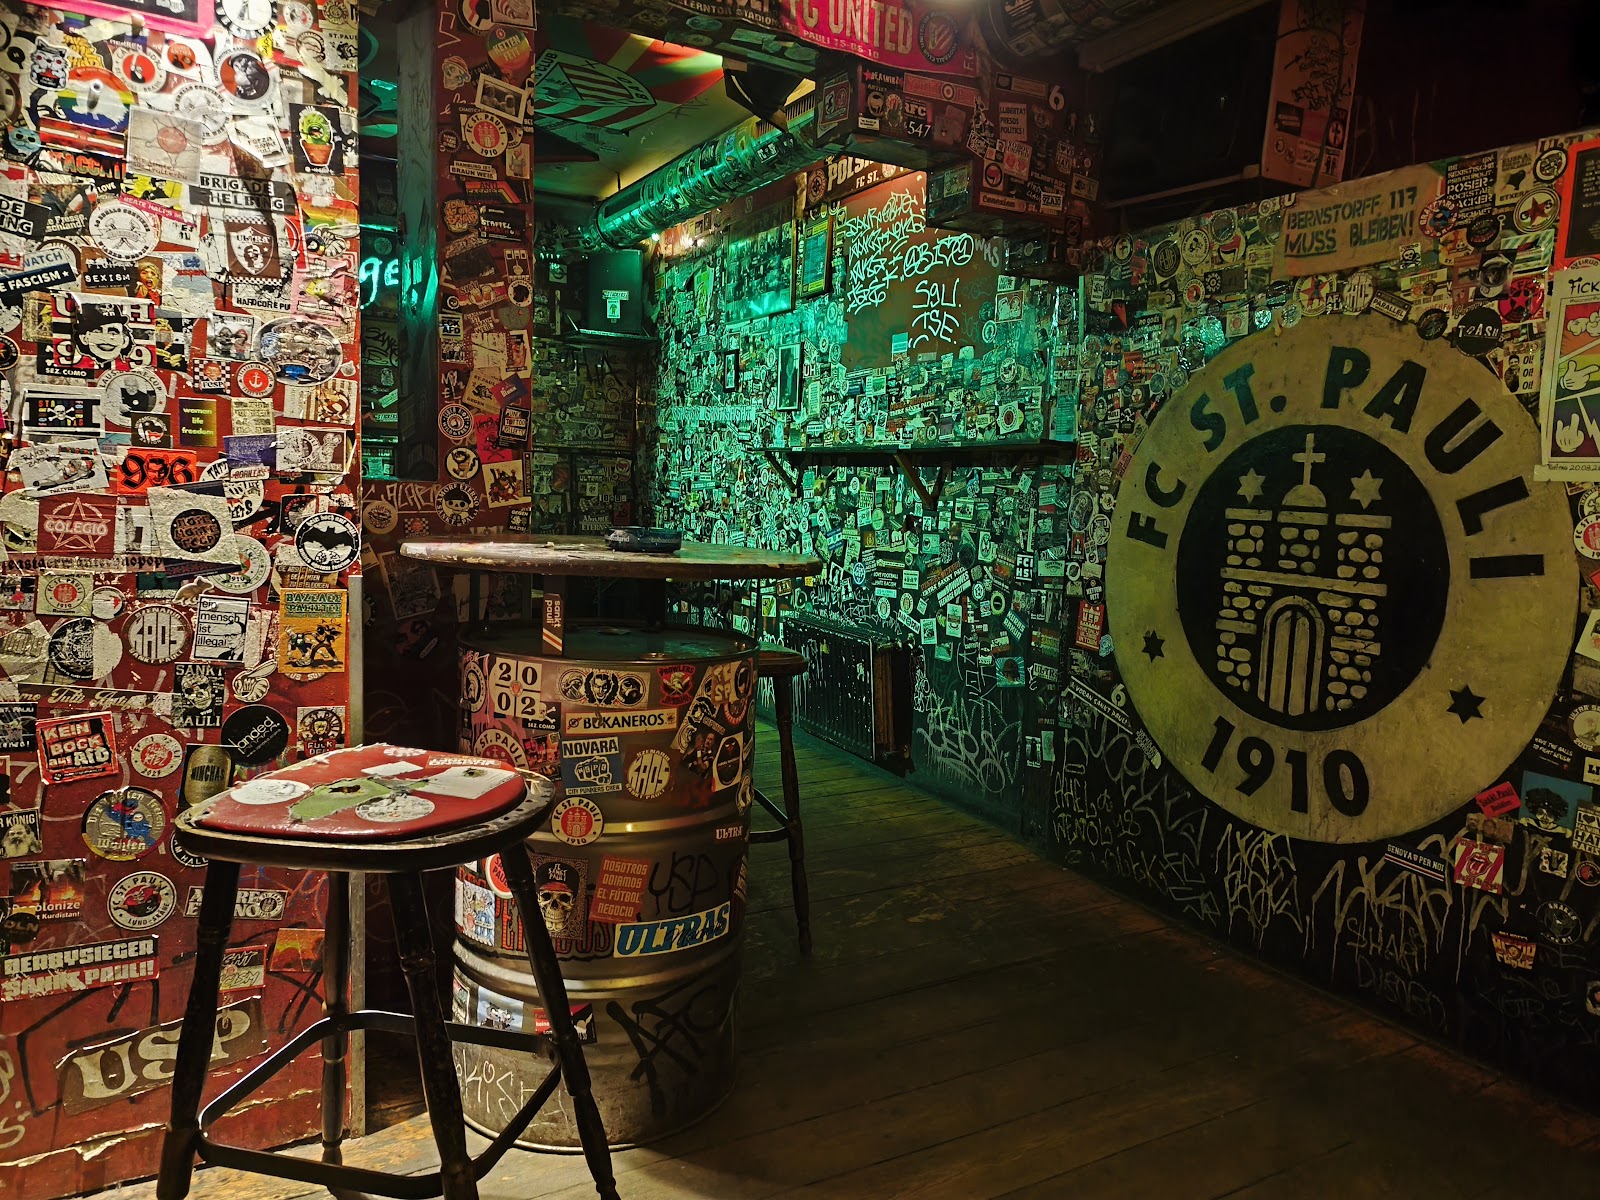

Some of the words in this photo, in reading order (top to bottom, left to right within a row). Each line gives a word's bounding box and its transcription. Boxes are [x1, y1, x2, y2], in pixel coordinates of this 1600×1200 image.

[789, 0, 819, 28] FC
[828, 0, 914, 54] UNITED
[493, 35, 521, 54] KETTEN
[803, 29, 830, 45] PAULI
[504, 50, 520, 62] FETT
[1049, 85, 1065, 111] 6
[472, 115, 482, 124] ST.
[485, 115, 505, 135] PAULI
[480, 148, 498, 156] 1910
[451, 167, 475, 177] BRAUN
[97, 182, 117, 193] LOVE
[200, 176, 274, 196] BRIGADE
[856, 177, 865, 189] FC
[867, 172, 880, 186] ST.
[1285, 228, 1337, 254] MUSS
[1350, 210, 1415, 247] BLEIBEN!
[8, 270, 61, 288] FASCISM
[85, 273, 131, 282] SEXISM
[236, 298, 278, 309] HARDCORE
[1373, 299, 1404, 316] PARALLEL
[442, 326, 460, 334] AFD
[62, 369, 87, 378] COMO
[467, 396, 485, 407] GEGEN
[183, 407, 213, 415] woman
[192, 417, 204, 425] life
[181, 427, 214, 435] freedom
[1126, 462, 1187, 550] FC
[1189, 362, 1287, 452] ST.
[1320, 346, 1546, 579] PAULI
[436, 484, 459, 502] AMORE
[460, 484, 480, 505] ETERNO
[436, 504, 456, 526] SANKT
[462, 508, 480, 525] PAULI
[44, 520, 109, 537] COLEGIO
[1576, 530, 1582, 539] FC
[1581, 518, 1593, 527] ST.
[1017, 557, 1034, 568] FCI
[66, 578, 82, 593] PAULI
[200, 612, 240, 624] mensch
[545, 599, 553, 624] pauli
[554, 600, 562, 628] sankt
[1083, 612, 1100, 624] USP
[199, 624, 211, 634] ist
[197, 635, 227, 647] illegal
[129, 648, 156, 663] SANKT
[159, 649, 184, 664] PAULI
[175, 664, 223, 677] SANKT
[1111, 683, 1127, 708] 6
[583, 713, 665, 729] BUKANEROS
[44, 722, 91, 741] KEIN
[50, 734, 104, 757] BOCK
[307, 740, 333, 750] FUCK
[495, 733, 526, 767] PAULI
[562, 740, 619, 757] NOVARA
[1558, 744, 1574, 757] BALLS
[1573, 738, 1593, 752] 2002
[48, 756, 74, 768] auf
[73, 747, 111, 767] AfD
[1200, 715, 1370, 817] 1910
[553, 809, 562, 820] FC
[561, 799, 574, 809] ST.
[578, 799, 602, 822] PAULI
[5, 813, 36, 828] KÖNIG
[566, 837, 587, 845] 1910
[1387, 844, 1412, 861] GENOVA
[1419, 857, 1432, 867] PER
[1433, 861, 1445, 872] NOI
[603, 859, 648, 875] NOSOTROS
[115, 883, 131, 896] ST.
[133, 876, 168, 892] PAULI
[602, 874, 643, 889] ODIAMOS
[597, 888, 607, 899] EL
[609, 888, 641, 904] FÚTBOL
[112, 898, 121, 911] FC
[598, 902, 635, 918] NEGOCIO
[42, 911, 81, 920] Kurdistan!
[616, 904, 730, 955] ULTRAS
[3, 939, 155, 976] DERBYSIEGER
[84, 959, 155, 985] PAULI!
[72, 1008, 251, 1099] USP
